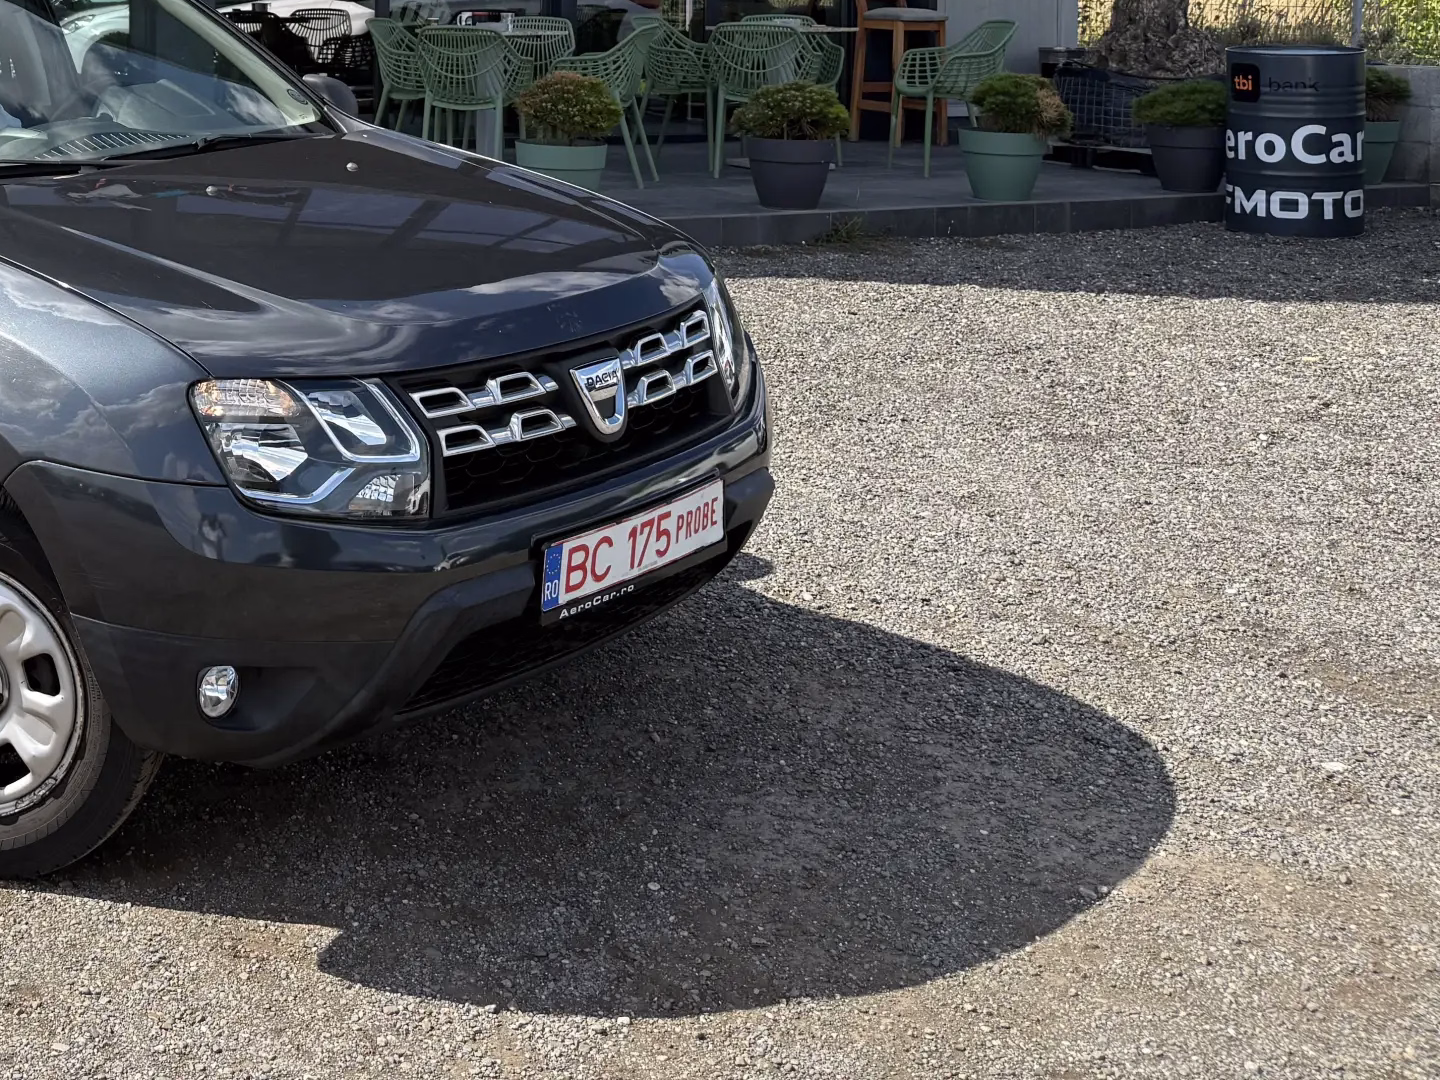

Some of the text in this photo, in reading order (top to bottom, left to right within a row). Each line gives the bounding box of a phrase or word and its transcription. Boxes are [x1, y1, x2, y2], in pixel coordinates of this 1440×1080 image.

[1234, 75, 1320, 92] tbi bank
[586, 369, 619, 387] DACIA
[565, 496, 719, 594] BC 175 PROBE
[544, 579, 559, 602] RO
[559, 584, 635, 620] AeroCar.ro
